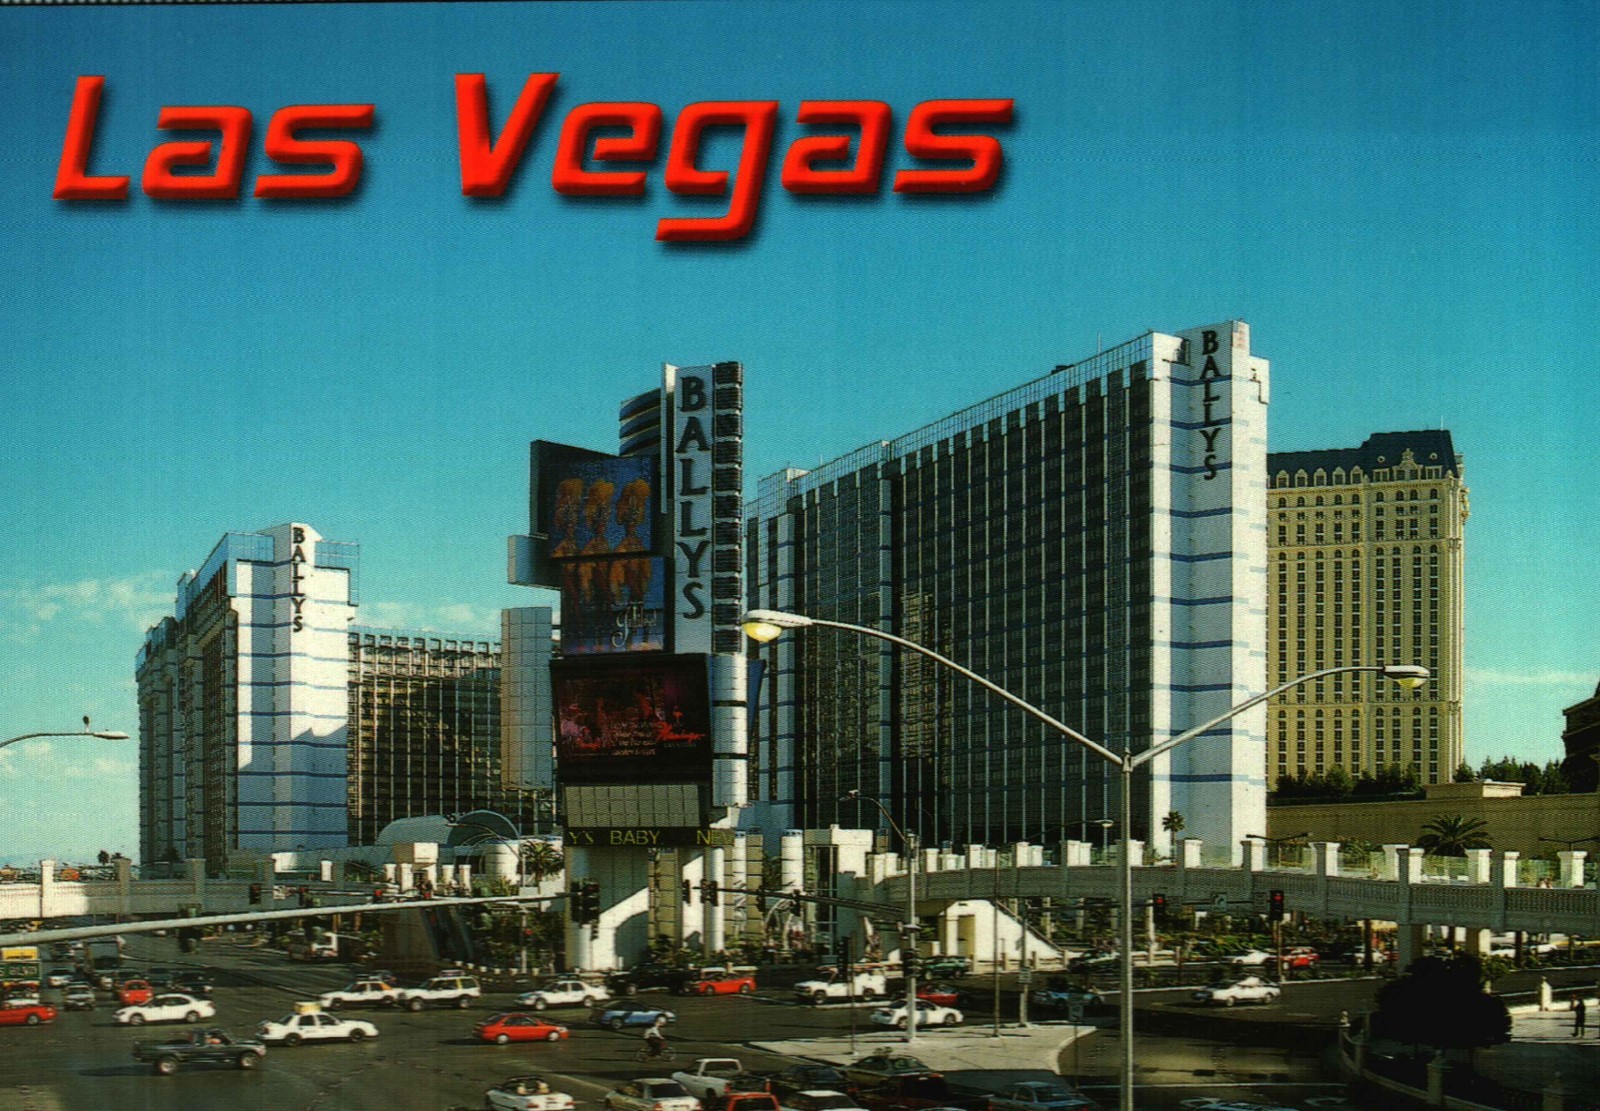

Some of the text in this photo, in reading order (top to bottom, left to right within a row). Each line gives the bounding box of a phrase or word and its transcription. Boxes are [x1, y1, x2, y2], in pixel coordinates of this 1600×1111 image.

[1199, 330, 1222, 480] BALLYS
[676, 375, 710, 620] BALLYS
[290, 526, 307, 633] BALLYS
